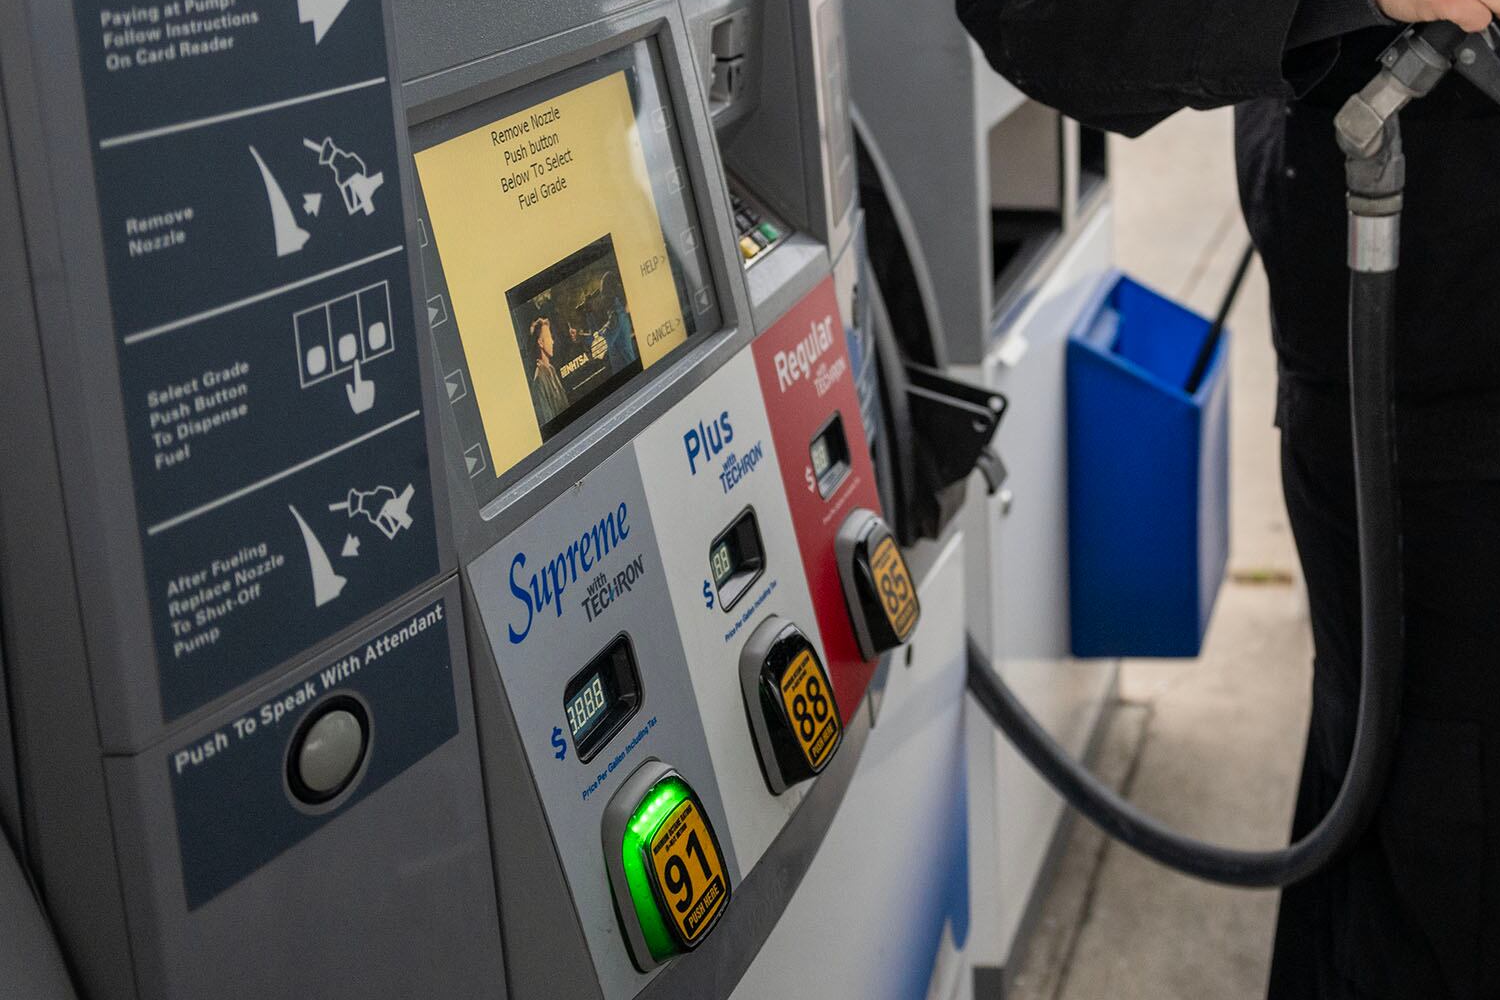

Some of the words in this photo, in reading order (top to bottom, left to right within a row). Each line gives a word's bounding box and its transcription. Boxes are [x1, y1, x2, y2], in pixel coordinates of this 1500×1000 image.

[101, 3, 159, 28] Paying
[164, 0, 181, 17] at
[103, 26, 162, 49] Follow
[166, 10, 259, 39] Instructions
[106, 53, 132, 71] On
[136, 43, 176, 65] Card
[180, 36, 235, 58] Reader
[491, 121, 530, 147] Remove
[530, 106, 561, 130] Nozzle
[503, 144, 528, 166] Push
[529, 132, 560, 155] button
[500, 169, 530, 193] Below
[530, 163, 545, 178] To
[545, 149, 574, 172] Select
[518, 188, 539, 210] Fuel
[540, 176, 567, 200] Grade
[126, 207, 194, 235] Remove
[128, 230, 187, 257] Nozzle
[640, 255, 659, 277] HELP
[646, 320, 675, 348] CANCEL
[774, 315, 833, 394] Regular
[146, 379, 199, 407] Select
[203, 360, 250, 390] Grade
[563, 352, 590, 374] NHTSA
[149, 403, 190, 429] Push
[194, 383, 248, 413] Button
[152, 431, 172, 449] To
[177, 403, 250, 441] Dispense
[154, 445, 191, 471] Fuel
[683, 411, 734, 476] Plus
[722, 451, 737, 472] with
[719, 439, 763, 495] TECHRON
[805, 467, 815, 493] $
[166, 569, 208, 597] After
[211, 542, 268, 579] Fueling
[168, 579, 232, 618] Replace
[235, 553, 285, 587] Nozzle
[508, 502, 631, 645] Supreme
[586, 572, 608, 596] with
[880, 562, 910, 616] 85
[172, 618, 191, 638] To
[195, 583, 262, 627] Shut-Off
[703, 580, 715, 610] $
[173, 626, 220, 658] Pump
[174, 732, 229, 775] Push
[233, 717, 257, 740] To
[260, 681, 317, 727] Speak
[320, 658, 361, 690] With
[364, 604, 444, 666] Attendant
[793, 675, 828, 742] 88
[551, 726, 568, 761] $
[582, 780, 598, 801] Price
[597, 770, 608, 785] Per
[607, 751, 626, 774] Gallon
[625, 724, 649, 756] Including
[646, 716, 658, 730] Tax
[664, 829, 713, 914] 91
[688, 905, 706, 929] PUSH
[703, 883, 720, 911] HERE
